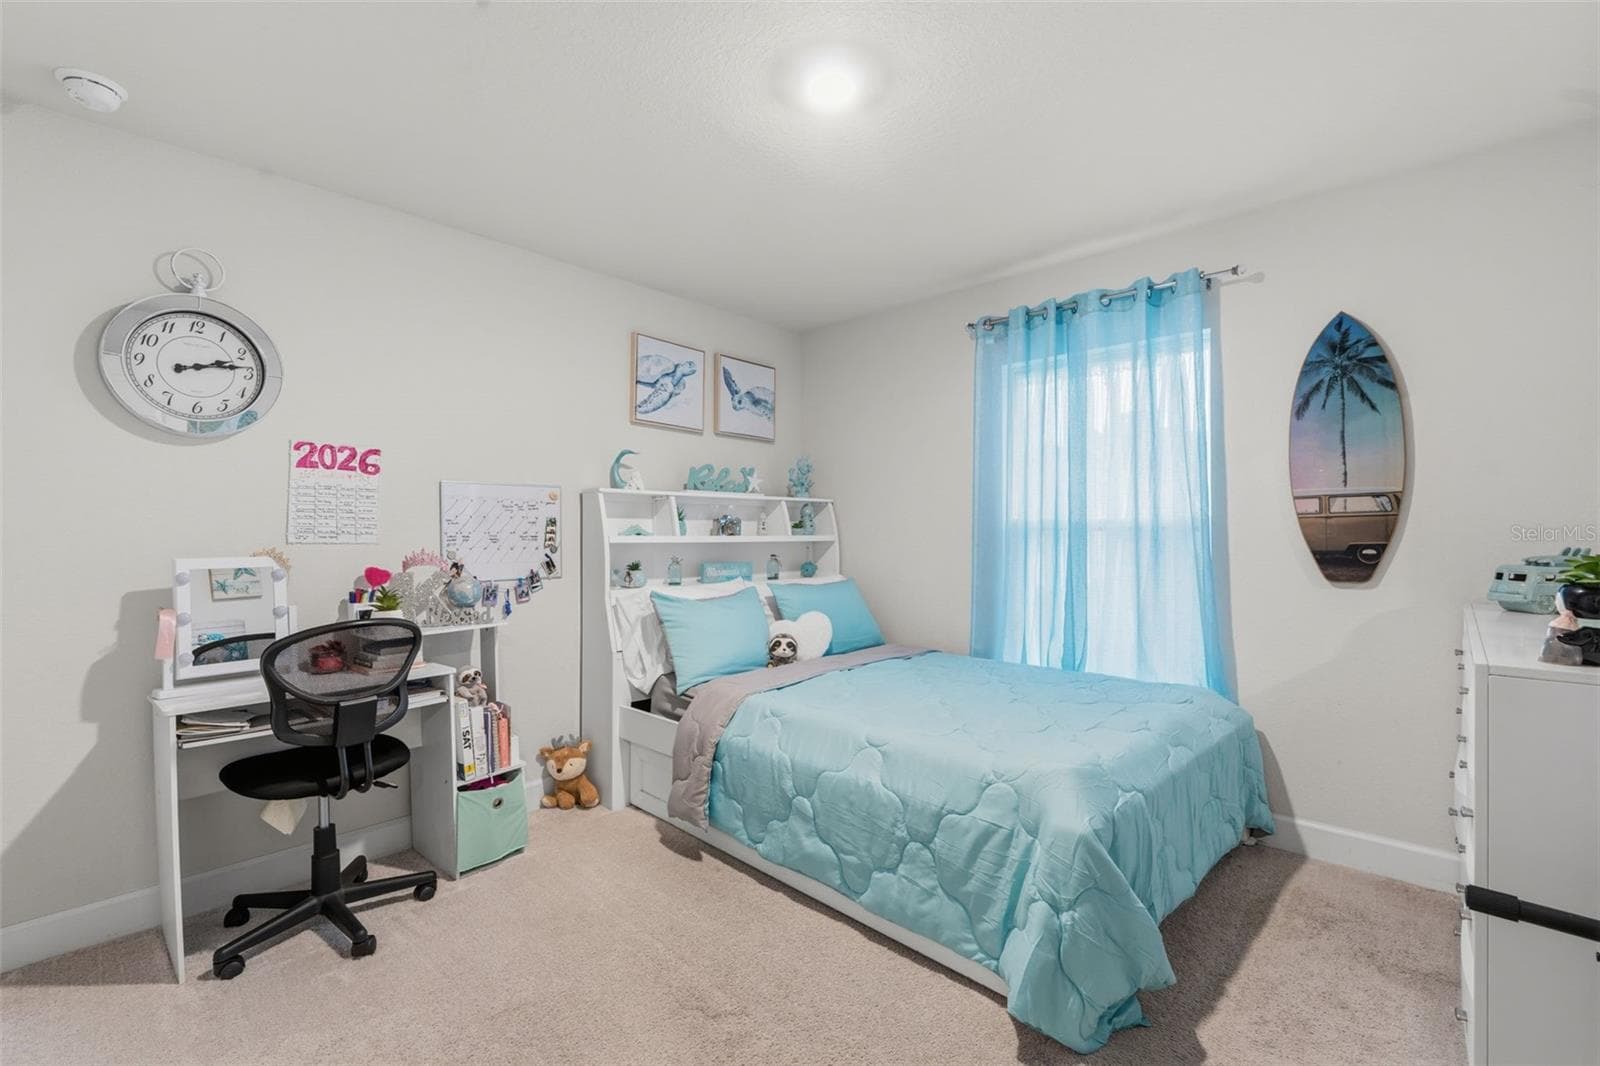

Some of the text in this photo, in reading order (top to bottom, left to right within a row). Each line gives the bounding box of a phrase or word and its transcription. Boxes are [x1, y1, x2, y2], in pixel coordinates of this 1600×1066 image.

[161, 321, 176, 334] 11
[189, 320, 206, 335] 12
[140, 333, 159, 347] 10
[219, 331, 226, 343] 1
[133, 352, 145, 366] 9
[237, 348, 247, 361] 2
[143, 374, 155, 388] 8
[243, 367, 254, 381] 3
[162, 390, 176, 406] 7
[236, 387, 247, 399] 4
[191, 401, 203, 414] 6
[216, 399, 230, 412] 5
[293, 441, 381, 475] 2026
[462, 730, 472, 750] SAT
